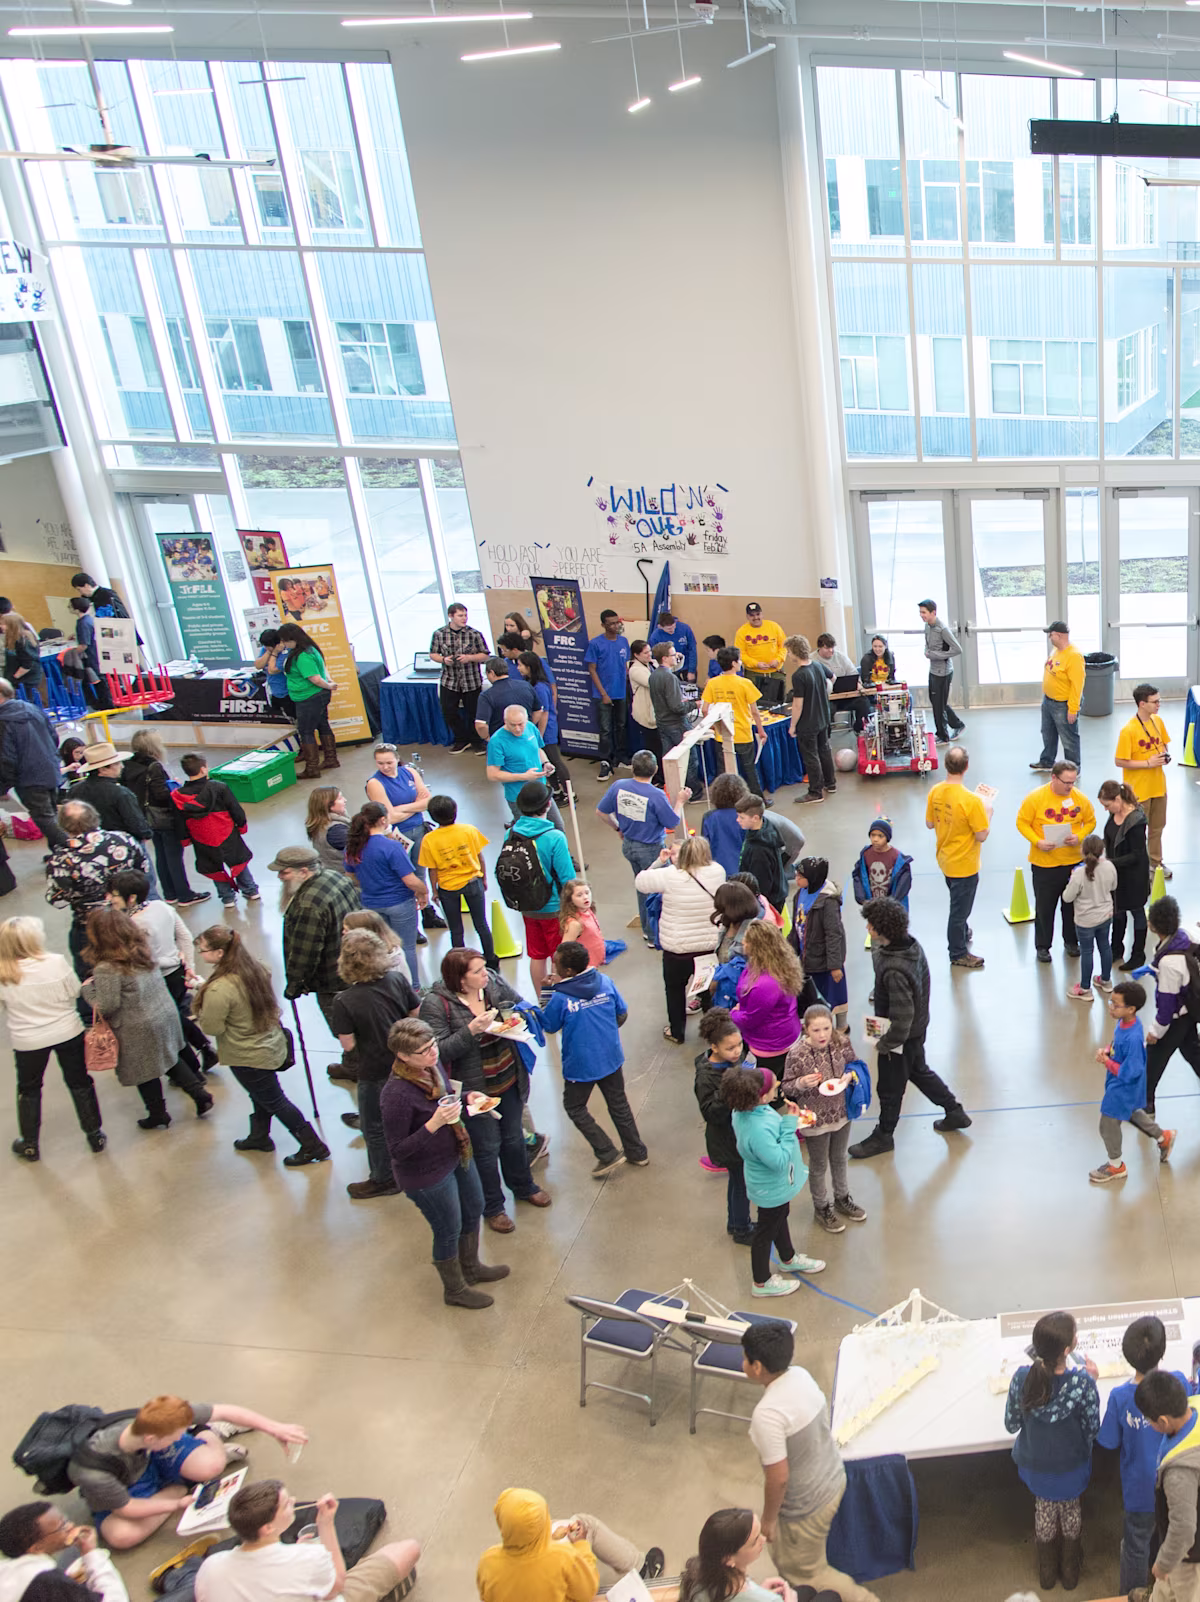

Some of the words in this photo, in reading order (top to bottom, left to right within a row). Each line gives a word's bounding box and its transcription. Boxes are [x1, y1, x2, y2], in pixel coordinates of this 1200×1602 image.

[0, 240, 32, 274] EW
[610, 483, 678, 516] WILD
[487, 544, 518, 562] HOLD
[652, 540, 687, 551] Assembly
[556, 546, 578, 562] YOU
[582, 547, 604, 563] ARE
[493, 561, 510, 575] TO
[515, 562, 542, 577] YOUR
[559, 561, 598, 576] PERFECT
[553, 635, 576, 646] FRC
[220, 699, 267, 713] FIRST
[865, 763, 880, 775] 44
